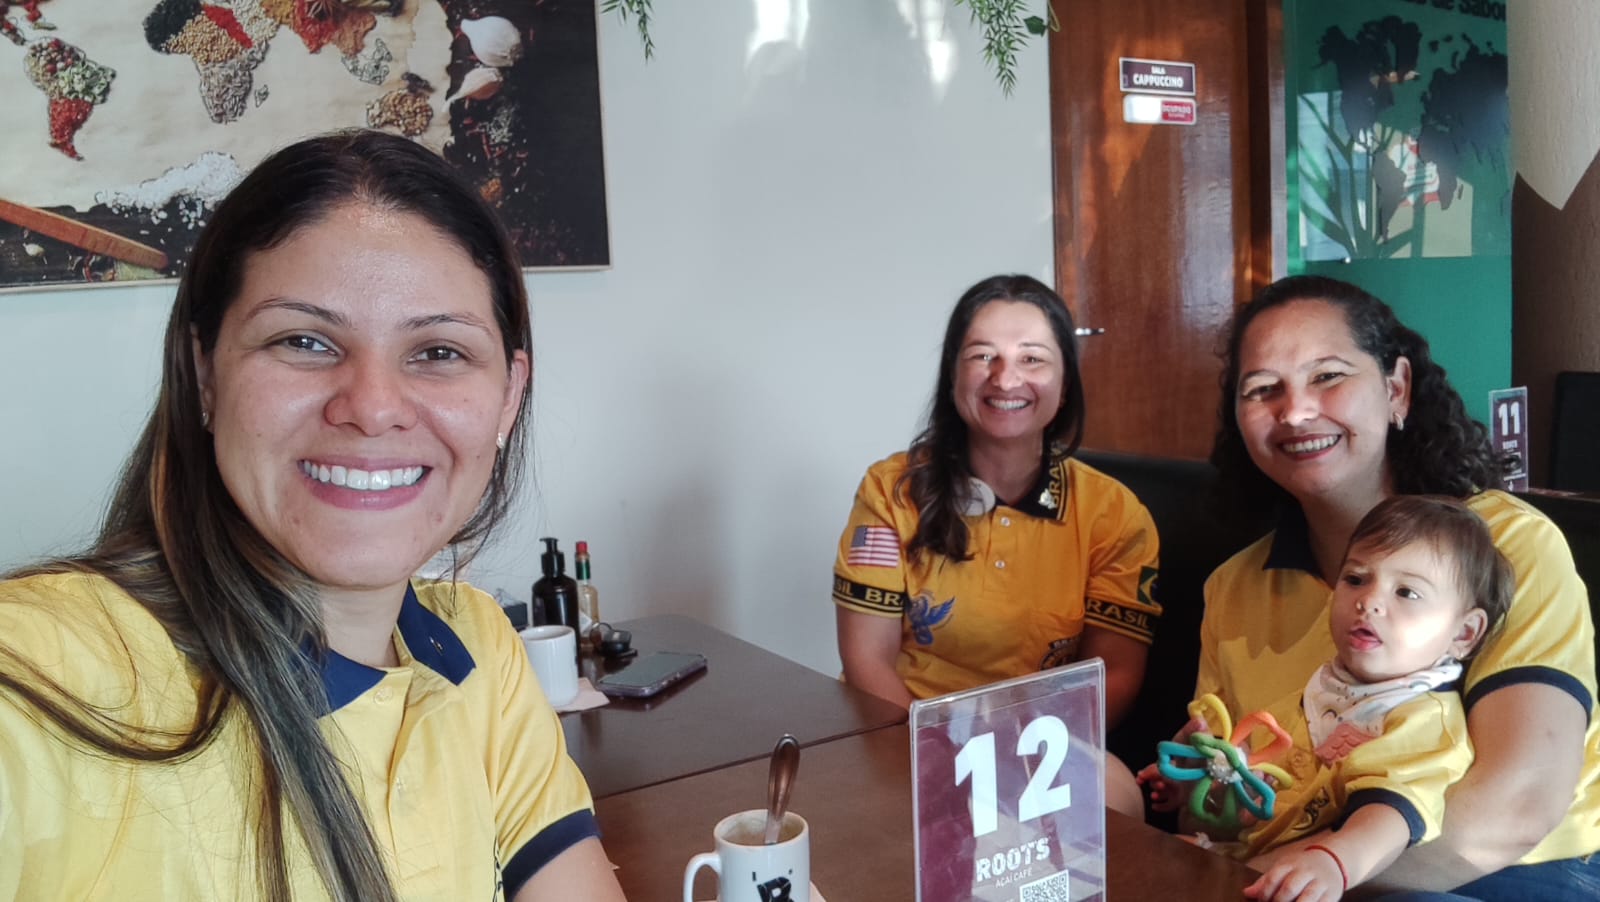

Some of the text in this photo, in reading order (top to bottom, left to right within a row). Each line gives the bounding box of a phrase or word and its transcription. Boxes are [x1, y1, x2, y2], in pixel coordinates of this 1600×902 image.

[1132, 73, 1184, 88] CAPPUCCINO
[1151, 65, 1166, 75] SALA
[1498, 401, 1521, 436] 11
[954, 714, 1072, 838] 12
[975, 837, 1051, 882] ROOTS
